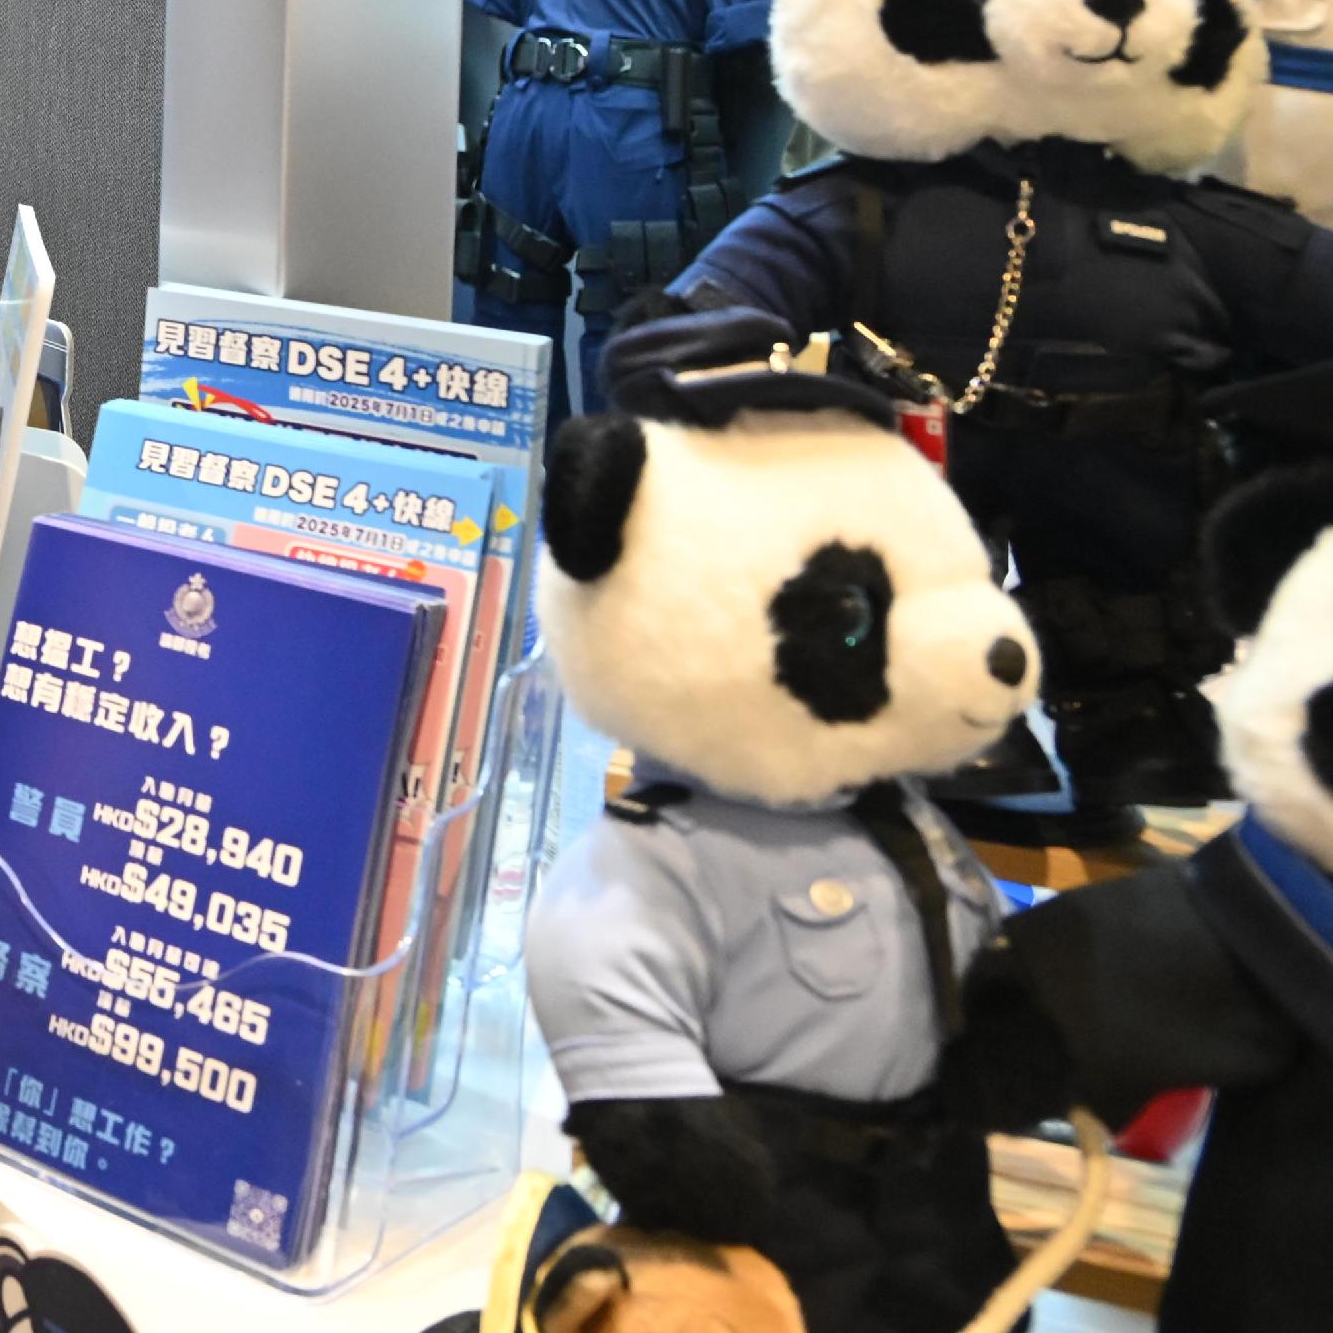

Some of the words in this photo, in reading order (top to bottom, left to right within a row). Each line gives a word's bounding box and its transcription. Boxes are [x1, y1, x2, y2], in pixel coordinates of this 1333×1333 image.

[154, 319, 281, 372] 見習督察
[287, 340, 371, 386] DSE
[137, 438, 259, 493] 見習督察
[261, 465, 340, 508] DSE
[1, 663, 230, 760] 想有穩定收入？
[93, 798, 303, 888] HKD$28,940
[80, 862, 291, 953] HKD$49,035
[48, 1013, 257, 1113] HKD$99,500
